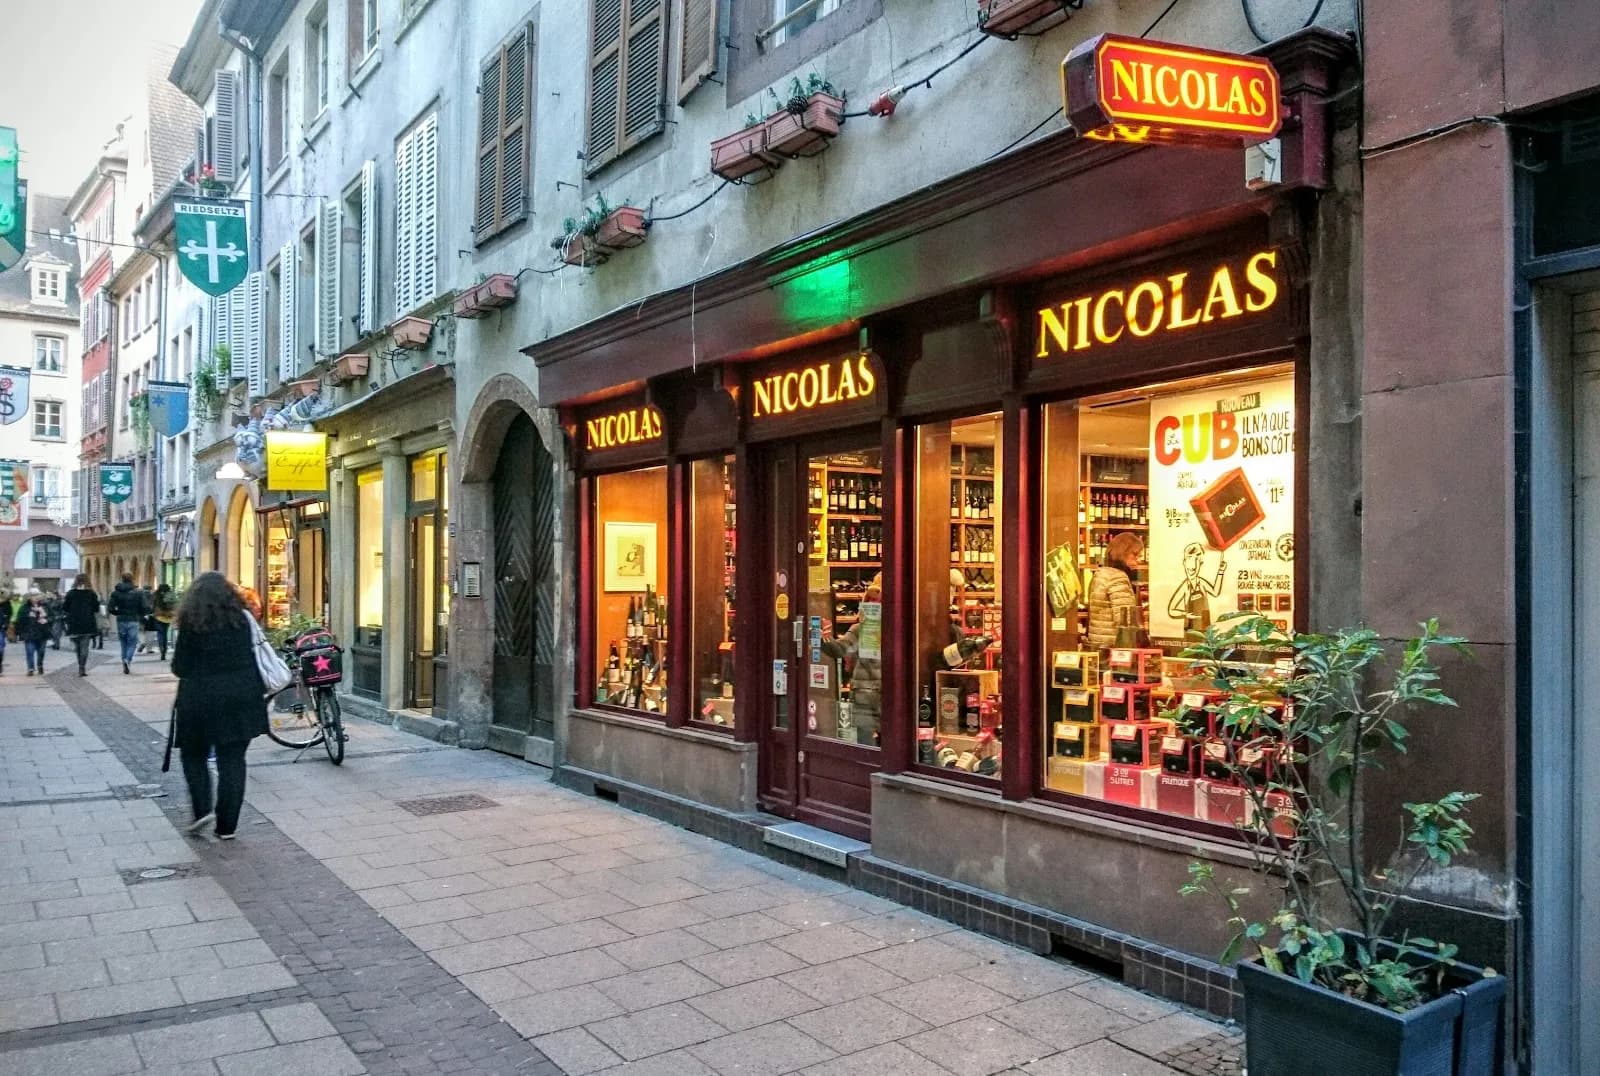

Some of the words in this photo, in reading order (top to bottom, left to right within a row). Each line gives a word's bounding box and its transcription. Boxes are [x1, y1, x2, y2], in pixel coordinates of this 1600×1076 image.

[1110, 59, 1267, 117] NICOLAS
[180, 204, 240, 216] RIEDSELTZ
[1036, 250, 1279, 358] NICOLAS
[752, 355, 876, 418] NICOLAS
[586, 407, 663, 451] NICOLAS
[1154, 411, 1240, 466] CUB
[1269, 411, 1290, 431] QUE
[1237, 570, 1249, 580] 23
